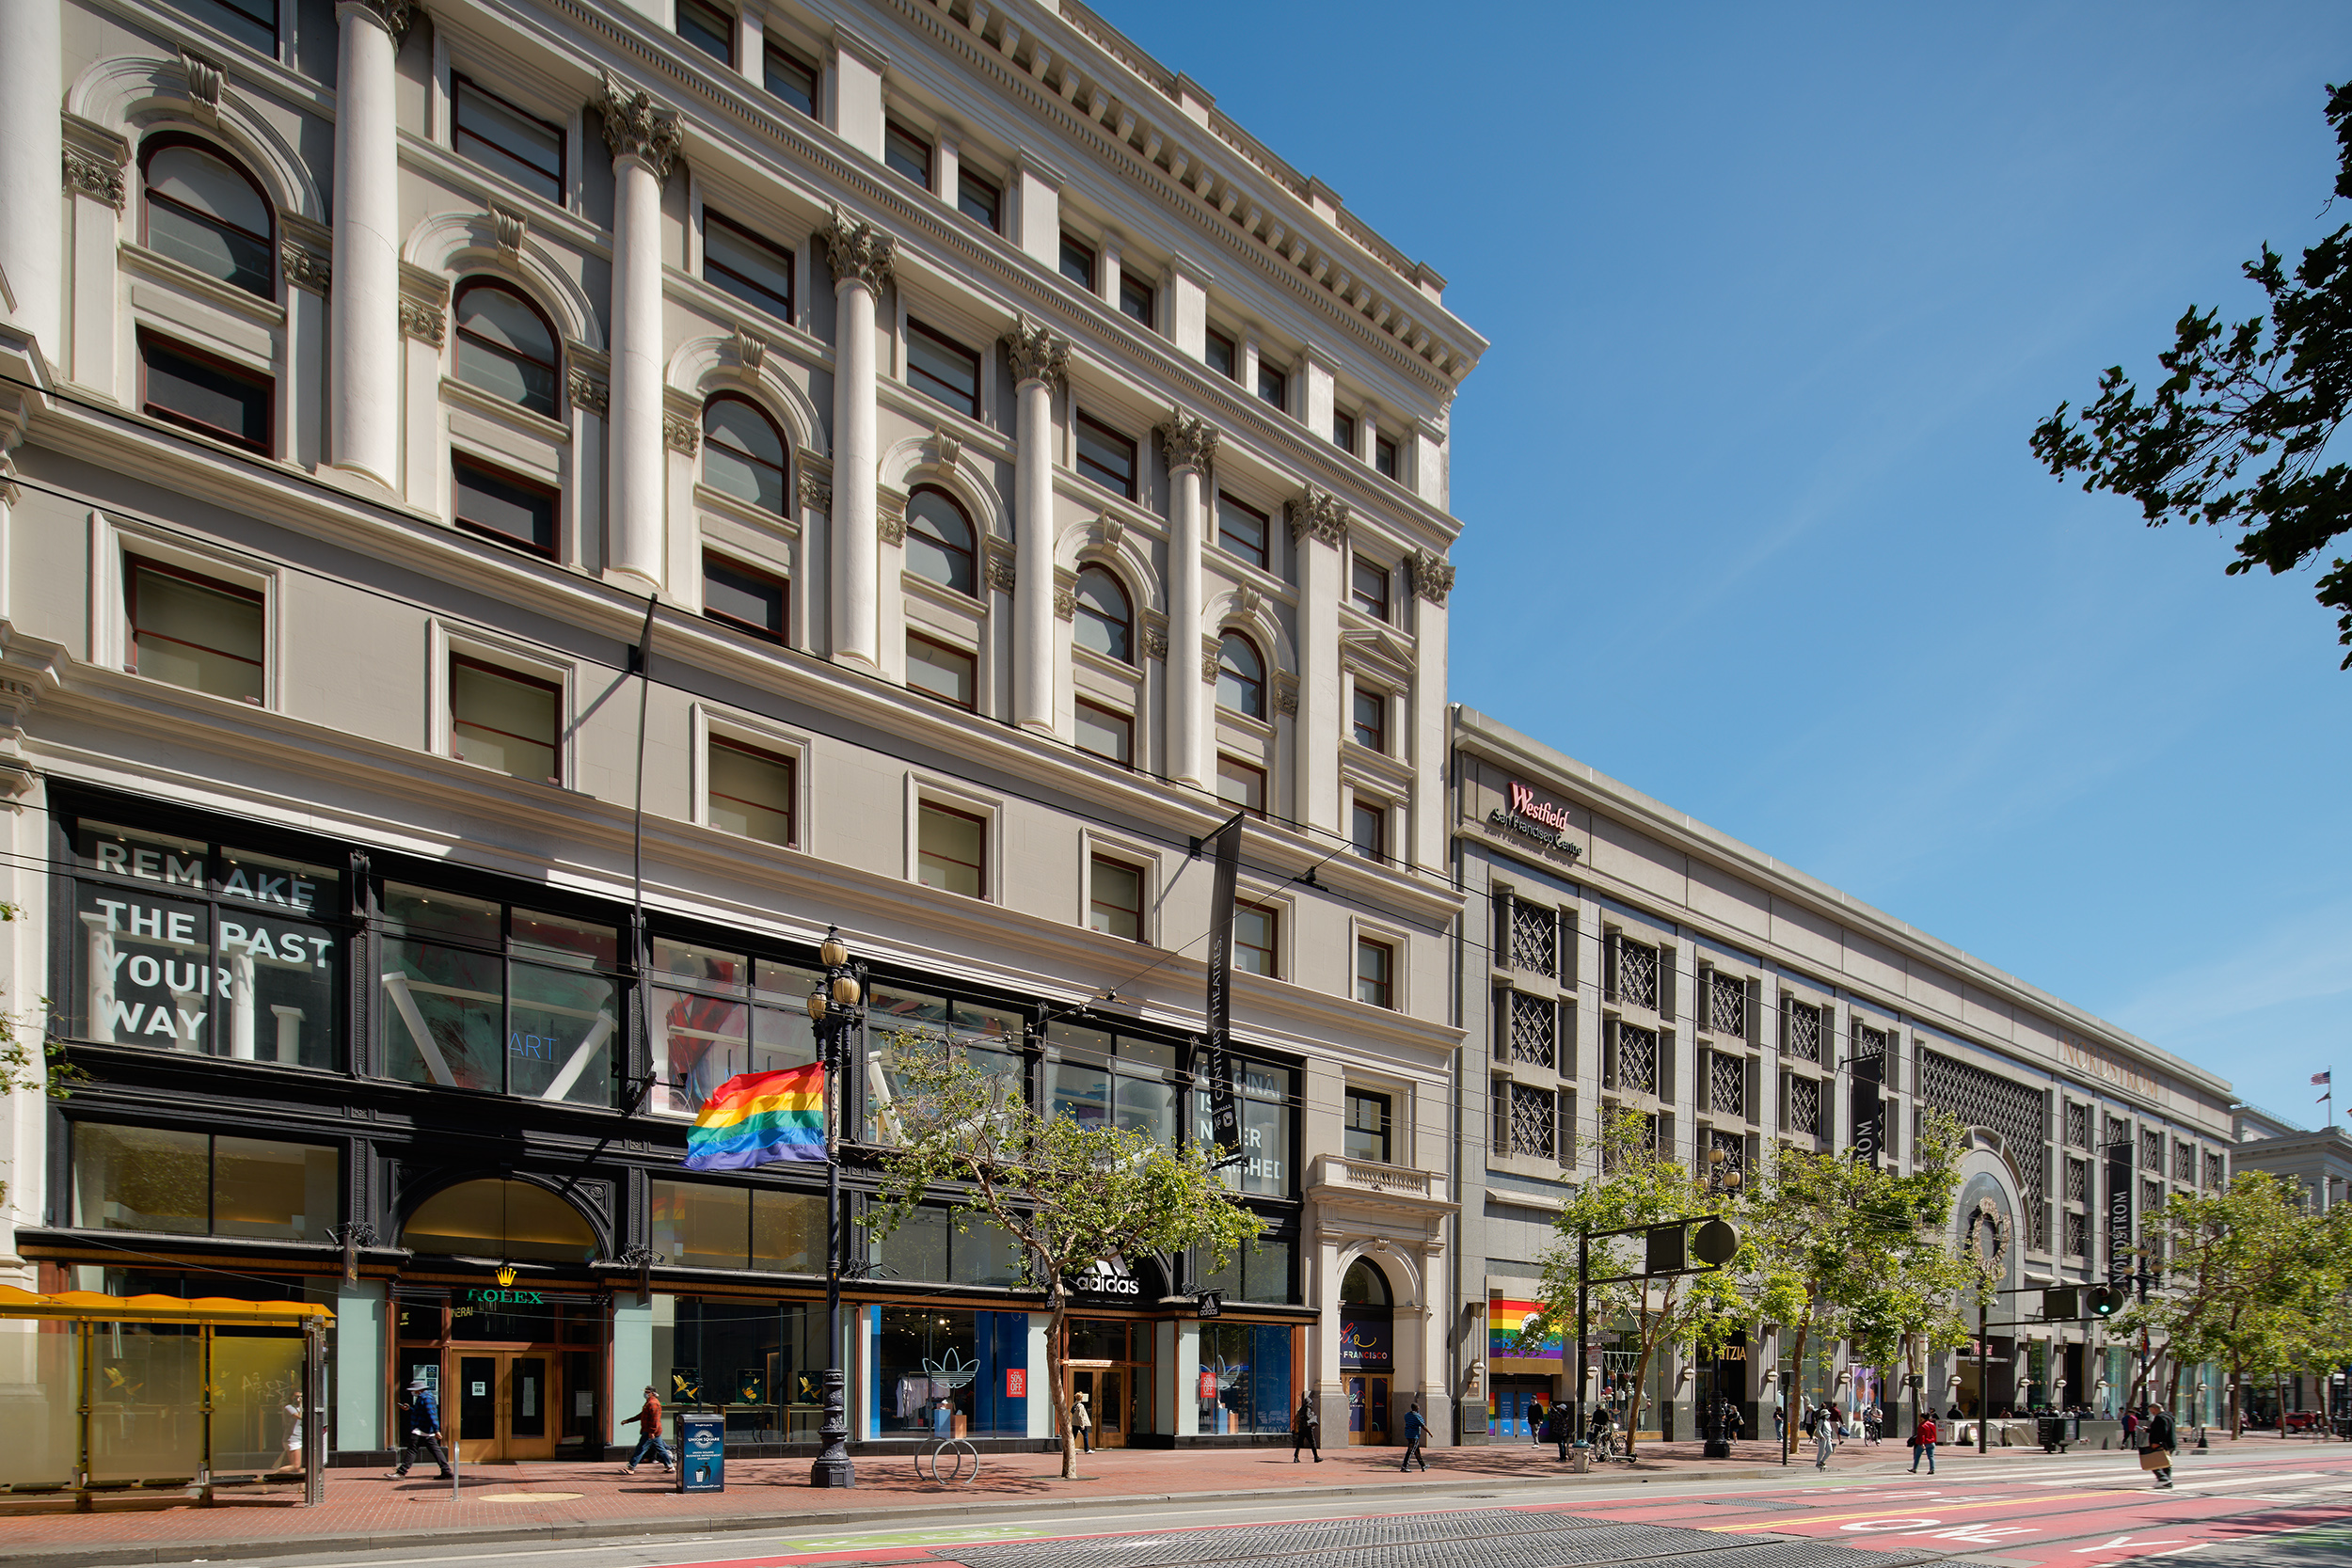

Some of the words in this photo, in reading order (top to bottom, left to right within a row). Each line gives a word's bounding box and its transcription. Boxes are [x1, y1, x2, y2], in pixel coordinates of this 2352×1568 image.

[1508, 782, 1570, 832] Westfield
[1492, 808, 1512, 826] San
[1514, 815, 1553, 844] Francisco
[1555, 832, 1582, 856] Centre
[95, 840, 316, 913] REMAKE
[95, 897, 196, 945] THE
[219, 920, 335, 969] PAST
[97, 947, 233, 1000] YOUR
[98, 995, 208, 1041] WAY
[509, 1033, 557, 1060] ART
[1213, 1026, 1224, 1101] CENTURY
[2063, 1034, 2158, 1100] NORDSTROM
[1200, 1119, 1262, 1148] NER
[2113, 1191, 2128, 1283] NORDSTROM
[467, 1289, 544, 1305] ROLEX
[1076, 1275, 1139, 1294] adidas
[1343, 1351, 1388, 1359] FRANCISCO
[1010, 1374, 1023, 1383] 50%
[1010, 1383, 1022, 1391] OFF
[1839, 1518, 2188, 1554] ONLY
